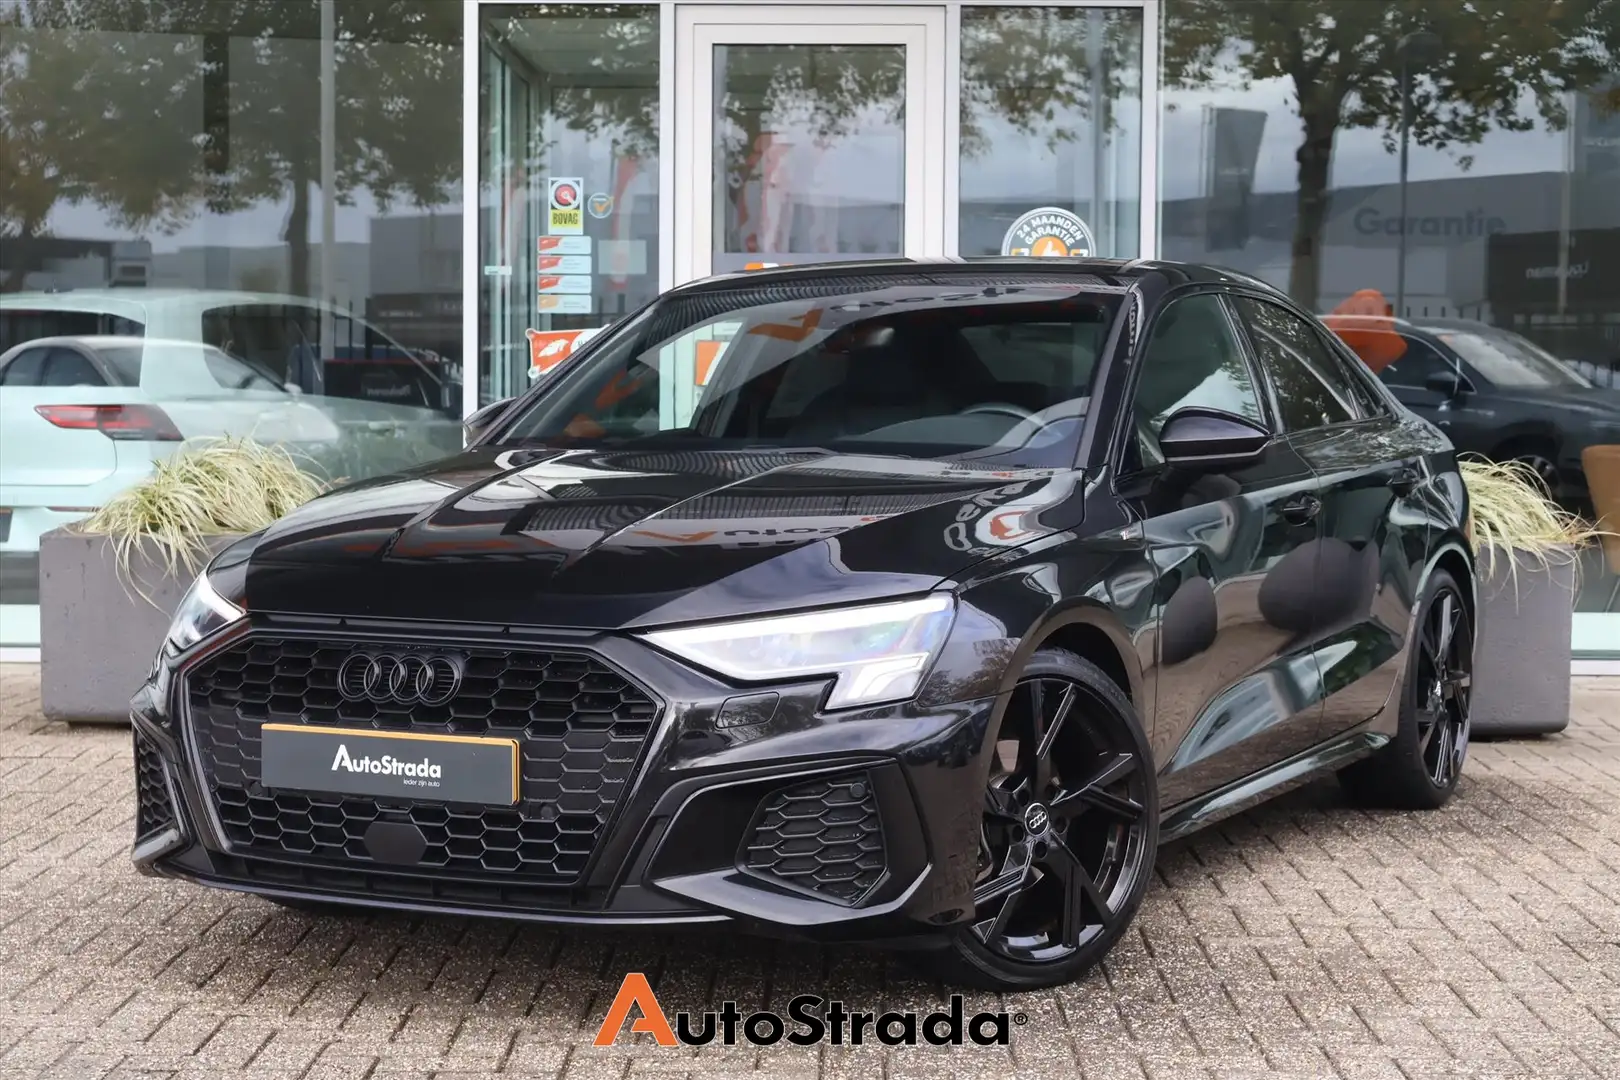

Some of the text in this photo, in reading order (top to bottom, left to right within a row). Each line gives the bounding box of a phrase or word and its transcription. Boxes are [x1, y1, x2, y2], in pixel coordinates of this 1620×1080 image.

[552, 212, 579, 225] BOVAG
[1016, 215, 1084, 240] 24 MAANDEN
[1353, 206, 1507, 236] Garantie
[1024, 226, 1075, 246] GARANTIE
[331, 744, 441, 778] AutoStrada
